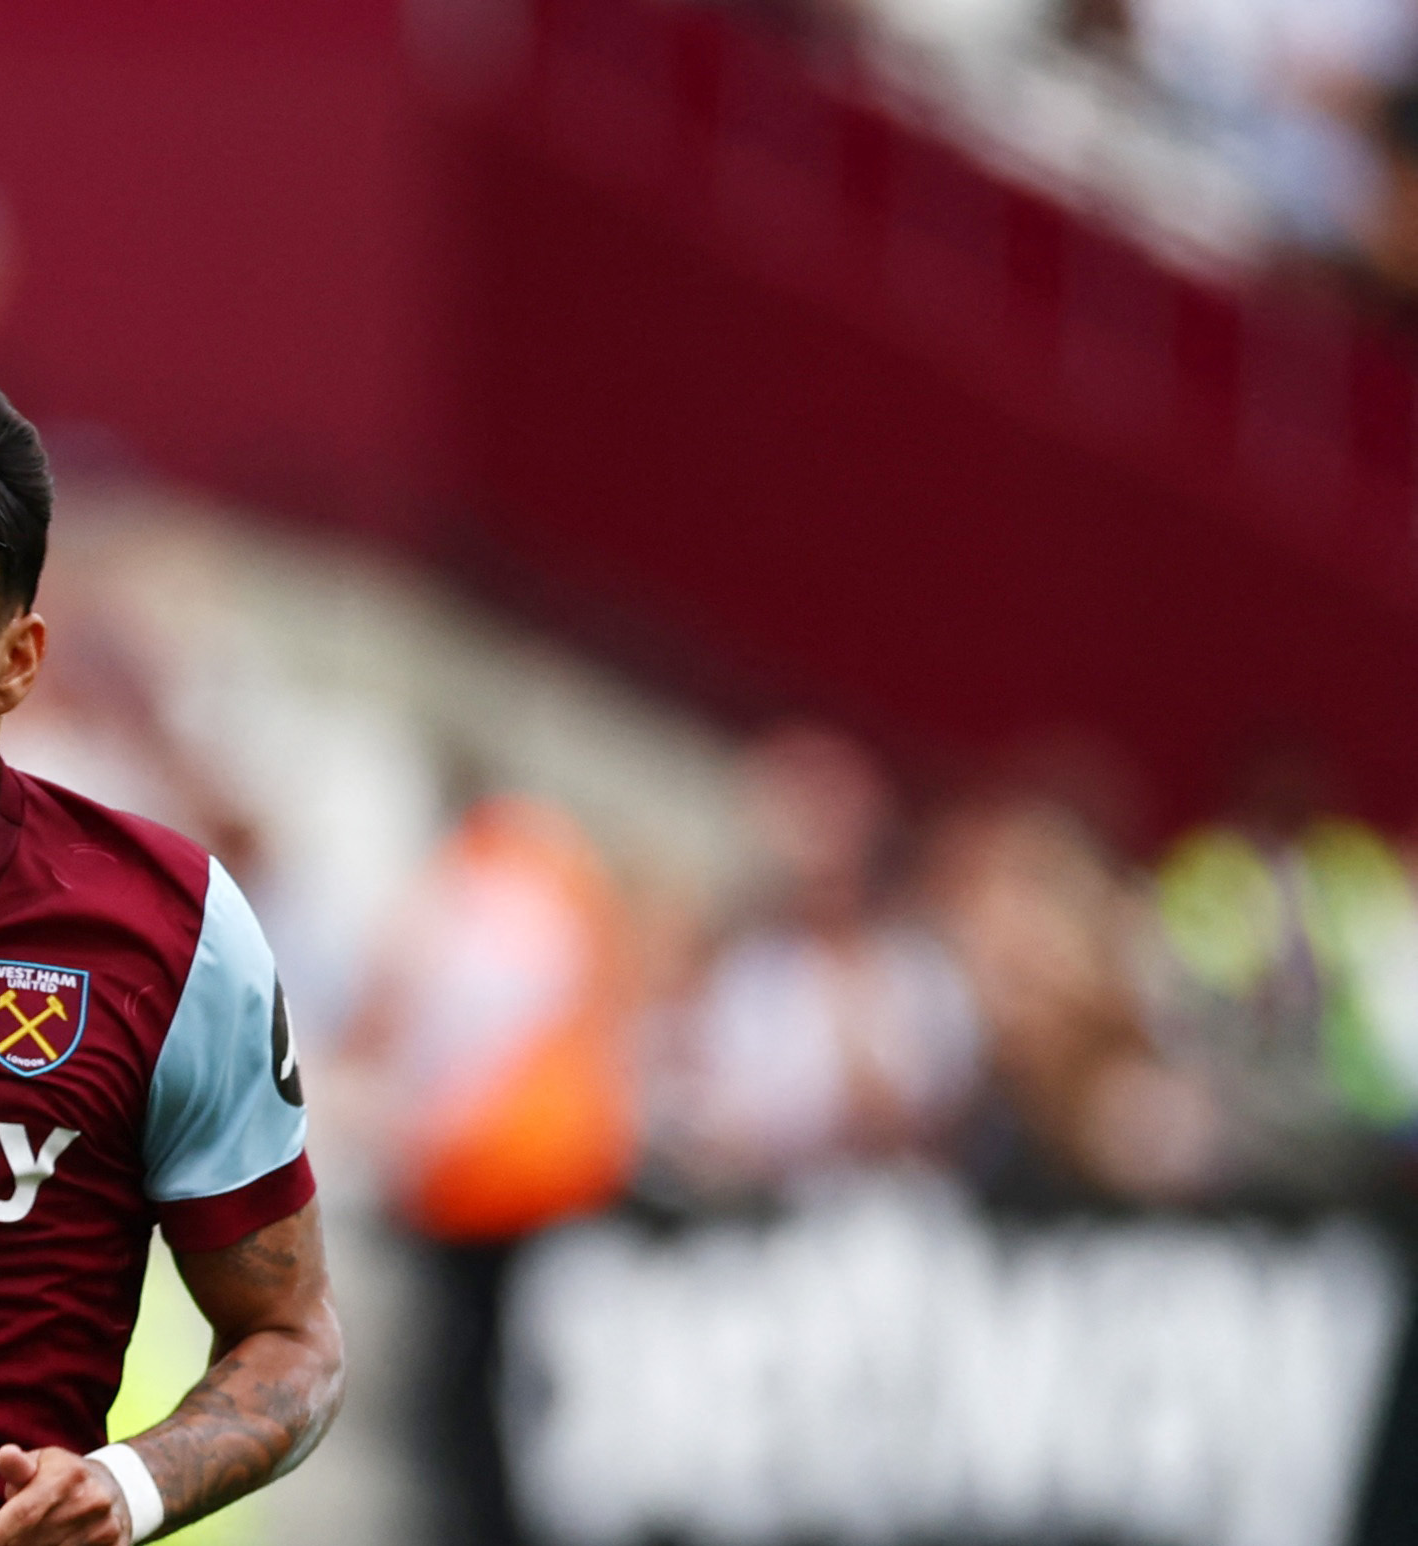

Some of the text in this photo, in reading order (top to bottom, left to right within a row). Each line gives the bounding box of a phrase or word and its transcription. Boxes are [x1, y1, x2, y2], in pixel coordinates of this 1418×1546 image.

[7, 978, 59, 994] UNITED
[36, 969, 77, 988] HAM
[6, 1053, 46, 1068] LONDON
